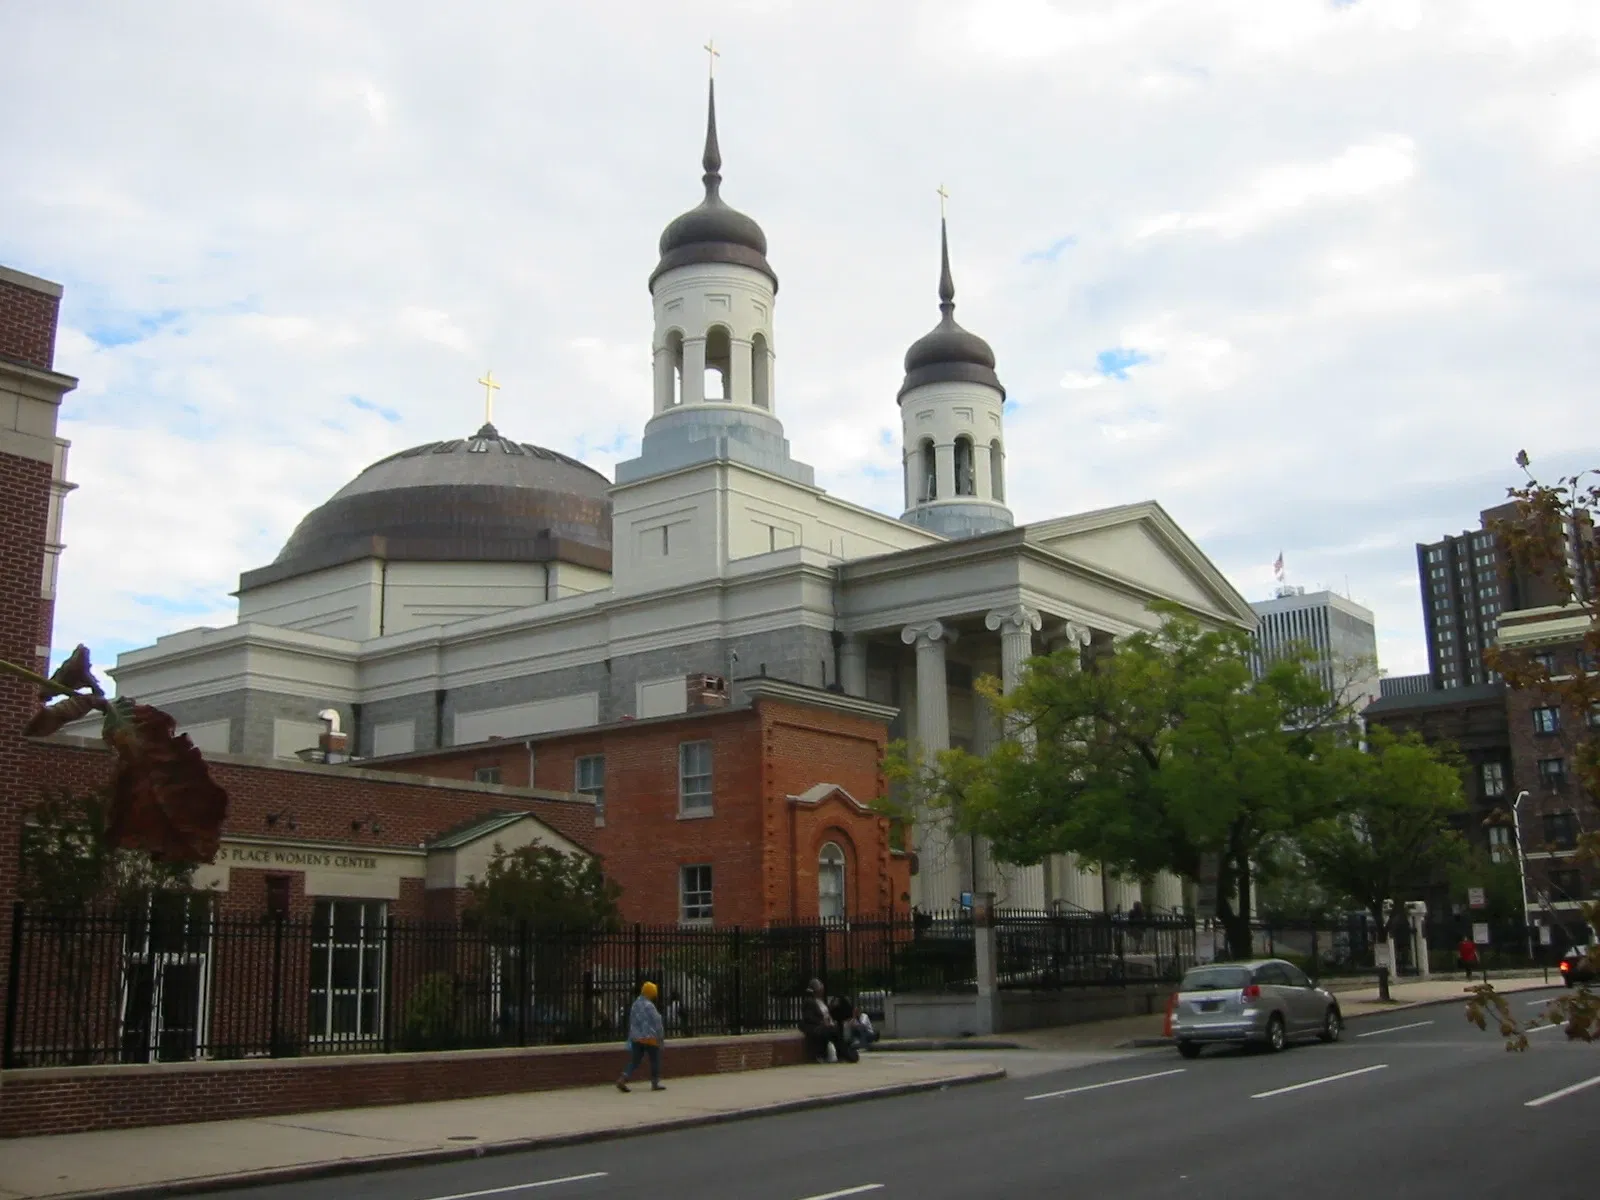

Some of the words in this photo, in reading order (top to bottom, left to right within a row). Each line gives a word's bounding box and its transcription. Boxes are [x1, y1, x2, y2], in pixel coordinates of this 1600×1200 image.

[232, 848, 271, 863] PLACE
[275, 851, 330, 867] WOMEN'S
[334, 855, 377, 869] CENTER
